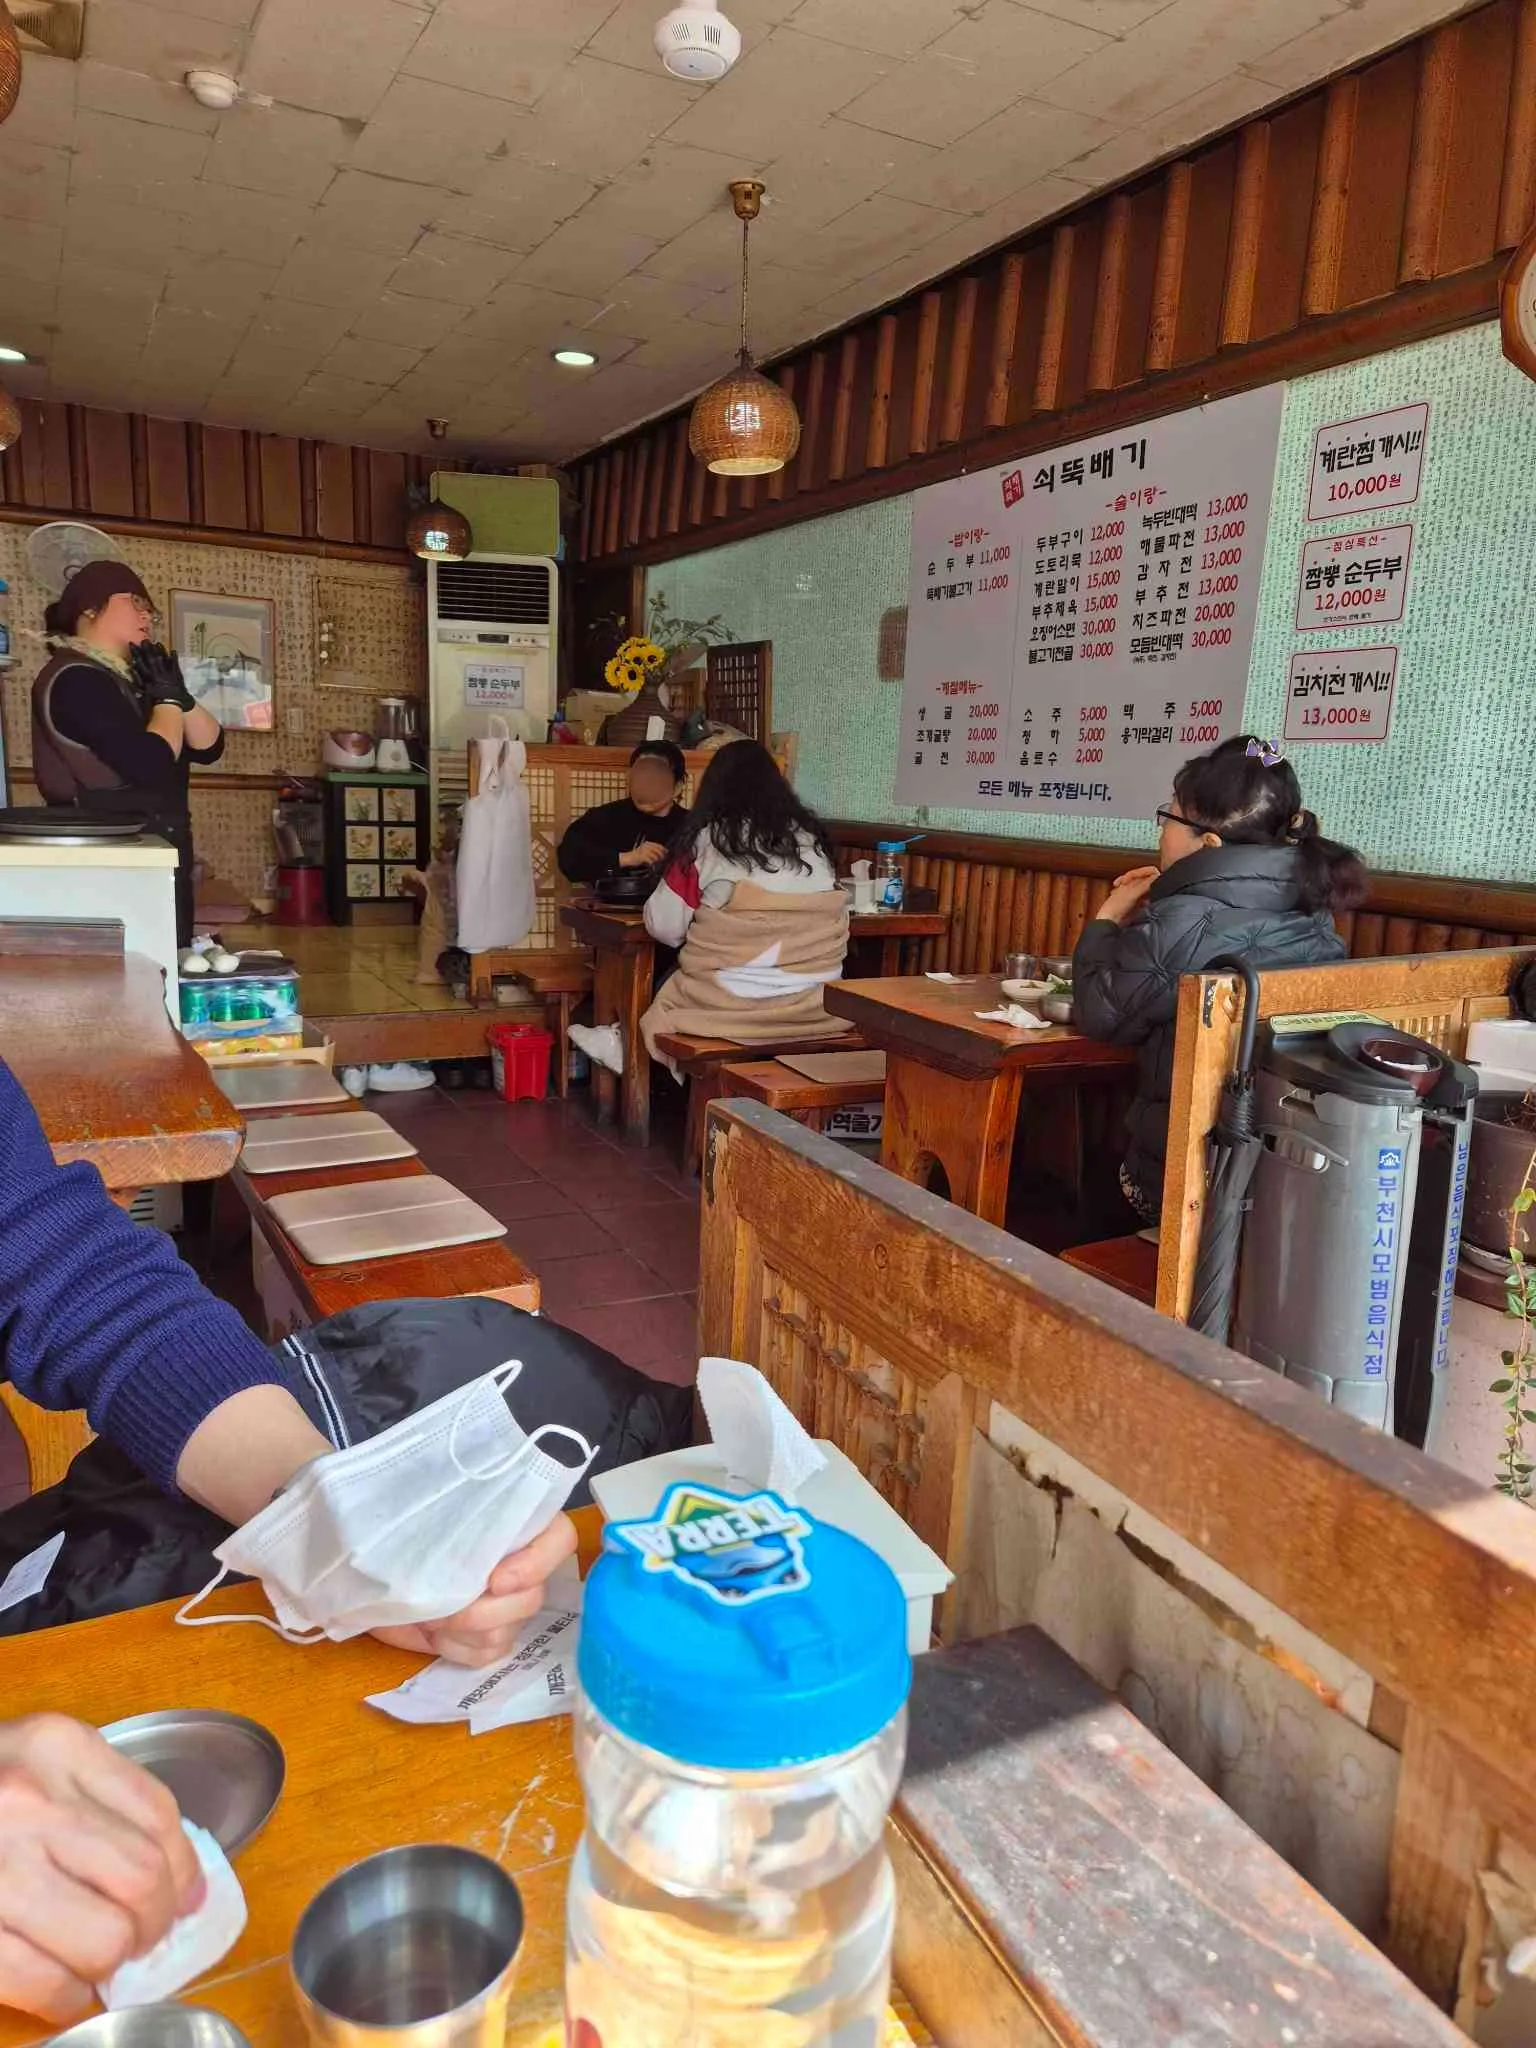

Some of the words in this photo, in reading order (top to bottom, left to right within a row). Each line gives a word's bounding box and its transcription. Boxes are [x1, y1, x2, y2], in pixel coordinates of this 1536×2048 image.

[1320, 438, 1376, 474] 계란찜
[1378, 430, 1422, 458] 개시!!
[1033, 438, 1148, 493] 쇠뚝배기
[1328, 473, 1402, 502] 10,000원
[1142, 503, 1198, 530] 녹두빈대떡
[1206, 493, 1248, 518] 13,000
[1036, 527, 1084, 552] 두부구이
[1090, 520, 1125, 542] 12,000
[1140, 529, 1195, 556] 해물파전
[1203, 520, 1245, 544] 13,000
[980, 546, 1010, 565] 11,000
[1035, 552, 1082, 576] 도토리묵
[1087, 544, 1123, 566] 12,000
[1200, 547, 1241, 569] 13,000
[977, 574, 1009, 592] 11,000
[1034, 575, 1080, 598] 계란말이
[1086, 569, 1121, 590] 15,000
[1305, 563, 1341, 590] 짬뽕
[1344, 555, 1402, 585] 순두부
[1198, 574, 1239, 596] 13,000
[1084, 593, 1118, 613] 15,000
[1315, 588, 1387, 611] 12,000원
[1132, 607, 1187, 630] 치즈파전
[1194, 601, 1235, 622] 20,000
[1081, 618, 1116, 636] 30,000
[1079, 641, 1113, 659] 30,000
[1129, 632, 1184, 654] 모듬빈대떡
[1191, 628, 1232, 648] 30,000
[1293, 671, 1346, 697] 김치전
[1349, 670, 1390, 694] 개시!!
[969, 703, 999, 718] 20,000
[1080, 705, 1107, 722] 5,000
[1189, 699, 1222, 717] 5,000
[1302, 707, 1371, 725] 13,000원
[967, 727, 997, 742] 20,000
[1078, 727, 1105, 743] 5,000
[1179, 725, 1219, 743] 10,000
[965, 750, 995, 766] 30,000
[1076, 748, 1103, 765] 2,000
[977, 780, 1003, 797] 모든
[1008, 780, 1034, 799] 메뉴
[1038, 781, 1112, 802] 포장됩니다.
[620, 1496, 799, 1560] TERRA
